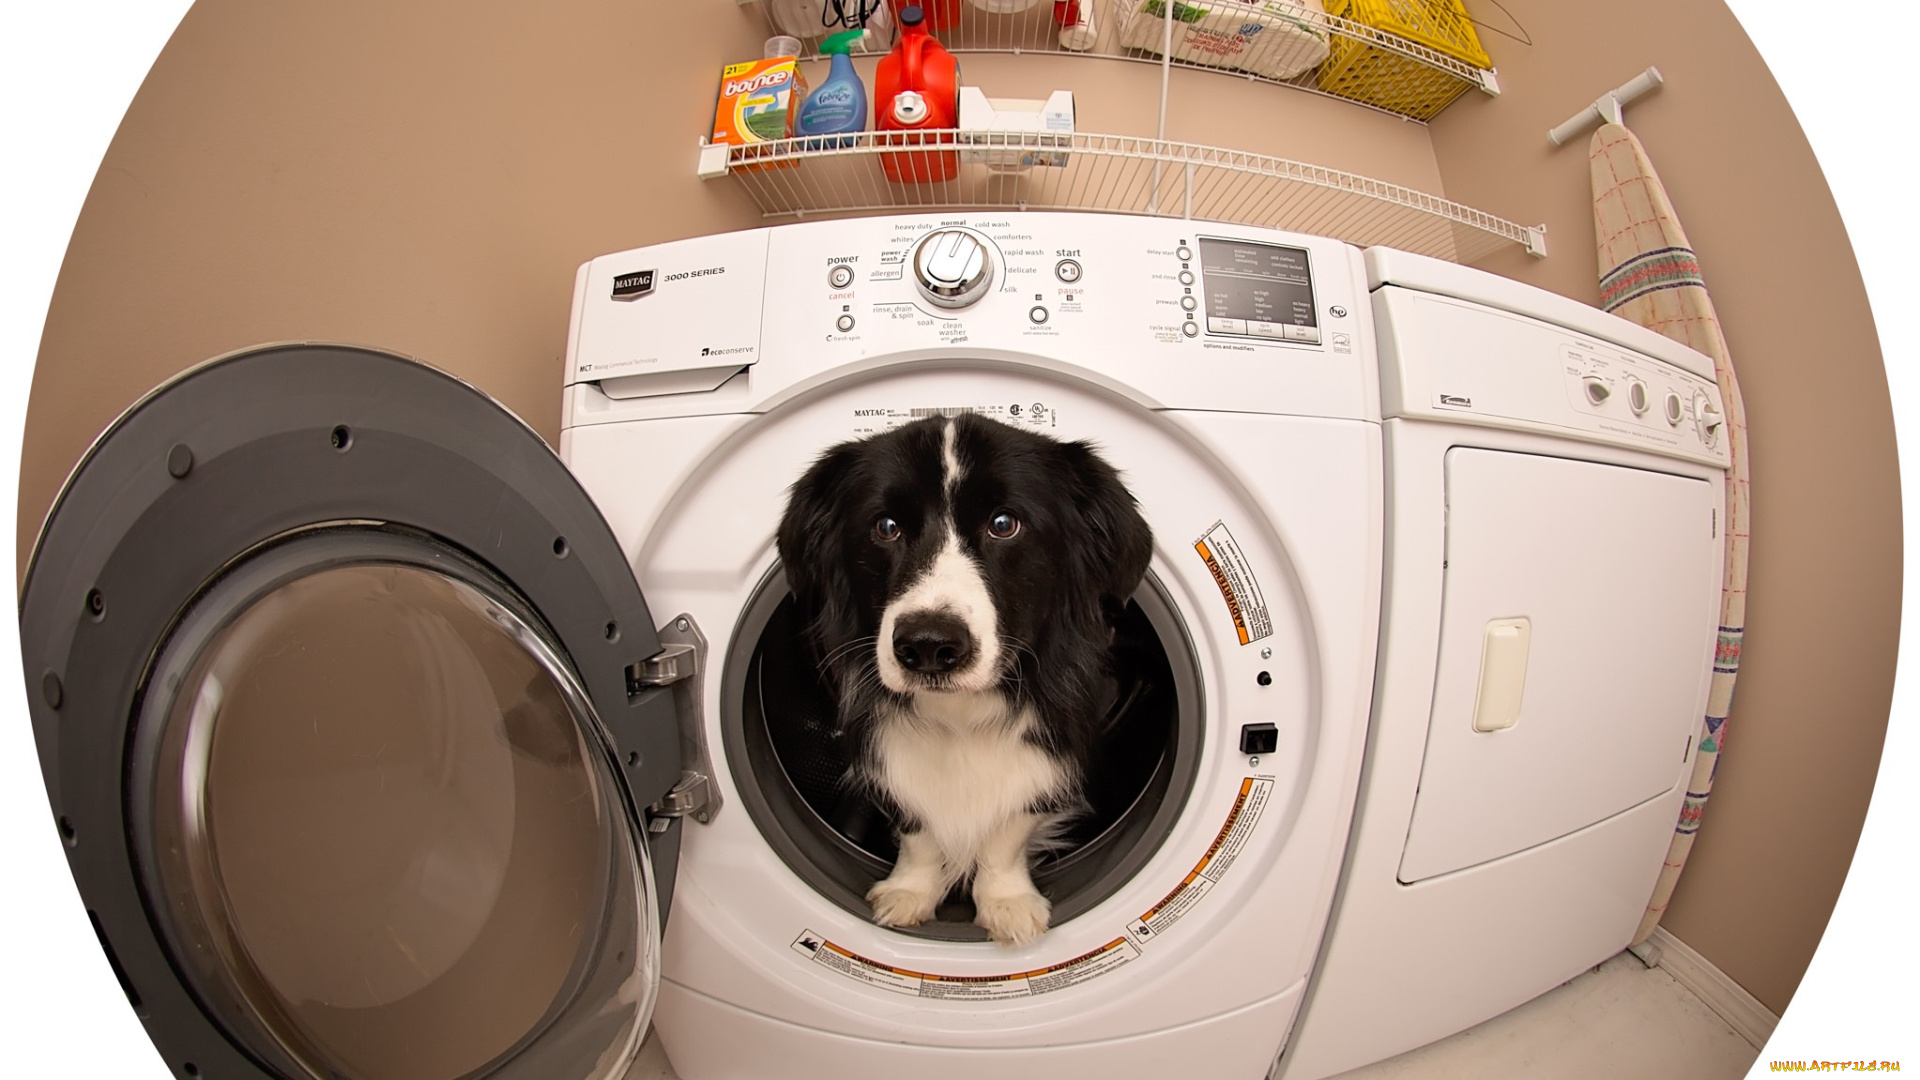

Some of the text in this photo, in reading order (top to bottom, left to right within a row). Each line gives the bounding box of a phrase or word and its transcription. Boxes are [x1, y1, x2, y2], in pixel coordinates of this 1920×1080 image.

[726, 65, 737, 75] 21
[724, 70, 789, 97] bounce
[917, 223, 933, 231] duty
[1056, 249, 1081, 257] start
[827, 255, 859, 266] power
[664, 267, 725, 282] 3000 SERIES
[870, 269, 900, 278] allergen
[615, 275, 650, 289] MAYTAG
[829, 291, 855, 300] cancel
[873, 306, 893, 314] rinse,
[710, 346, 754, 356] ecoconserve
[580, 364, 592, 372] MCT
[854, 408, 885, 417] MAYTAG
[1206, 555, 1243, 622] ADVERTENCIA
[1211, 793, 1247, 853] AVERTISSEMENT
[1157, 882, 1188, 911] WARNING
[1054, 947, 1108, 969] ADVERTENCIA
[856, 956, 894, 972] WARNING
